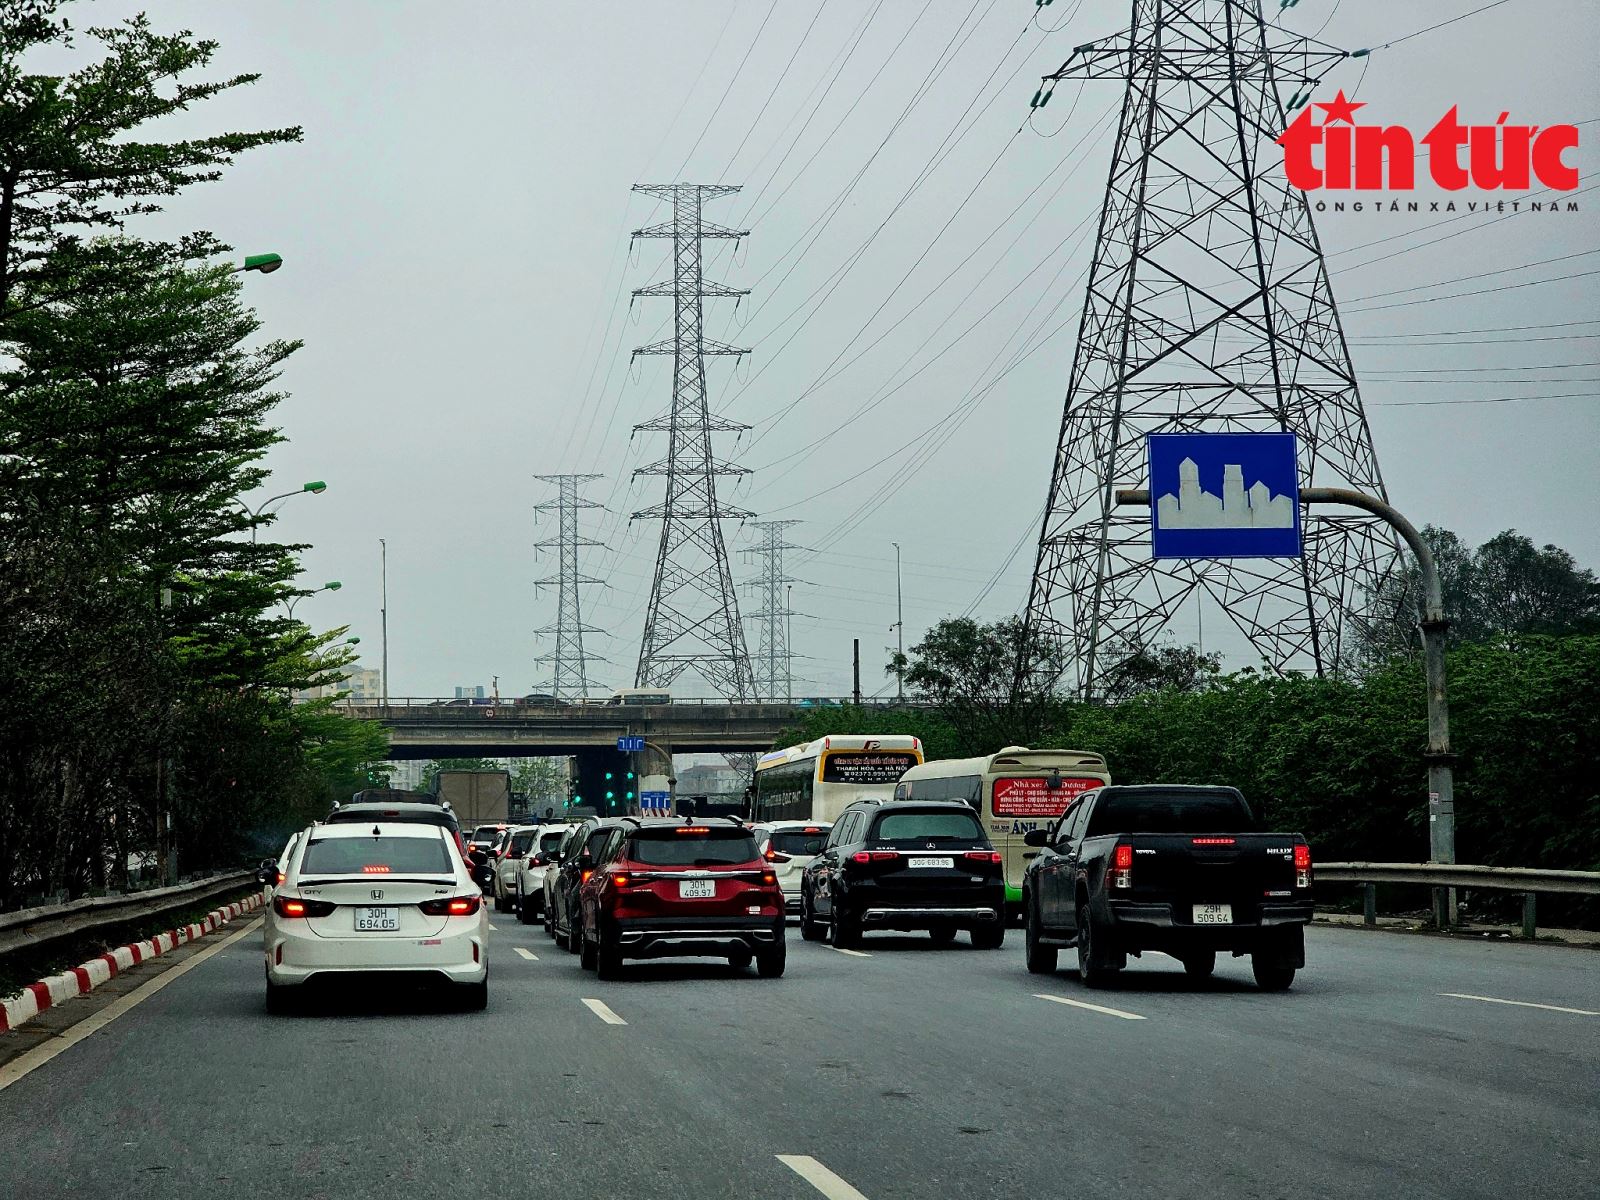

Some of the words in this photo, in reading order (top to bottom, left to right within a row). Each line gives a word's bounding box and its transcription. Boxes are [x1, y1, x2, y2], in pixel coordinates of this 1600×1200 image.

[690, 880, 705, 889] 30H
[684, 889, 711, 897] 409.97
[367, 908, 387, 919] 30H
[1204, 904, 1221, 914] 29H
[1197, 914, 1228, 923] 509.64
[359, 919, 395, 929] 694.05
